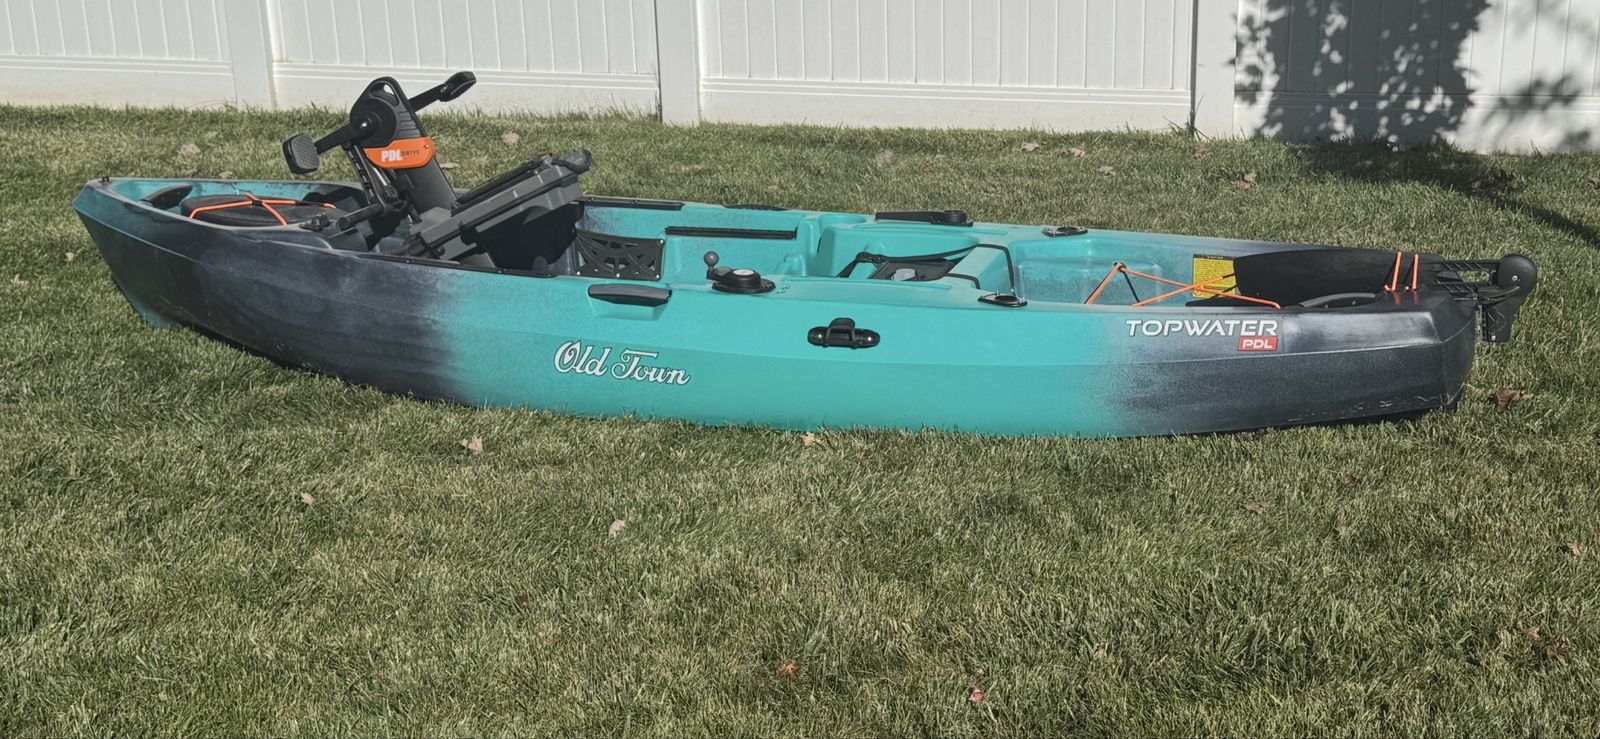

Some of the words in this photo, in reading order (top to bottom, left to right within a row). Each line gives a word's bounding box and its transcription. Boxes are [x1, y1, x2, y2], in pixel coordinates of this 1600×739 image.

[381, 149, 403, 162] PDL
[1126, 320, 1279, 336] TOPWATER
[1242, 339, 1273, 349] PDL
[554, 340, 612, 377] Old
[611, 347, 691, 385] Town
